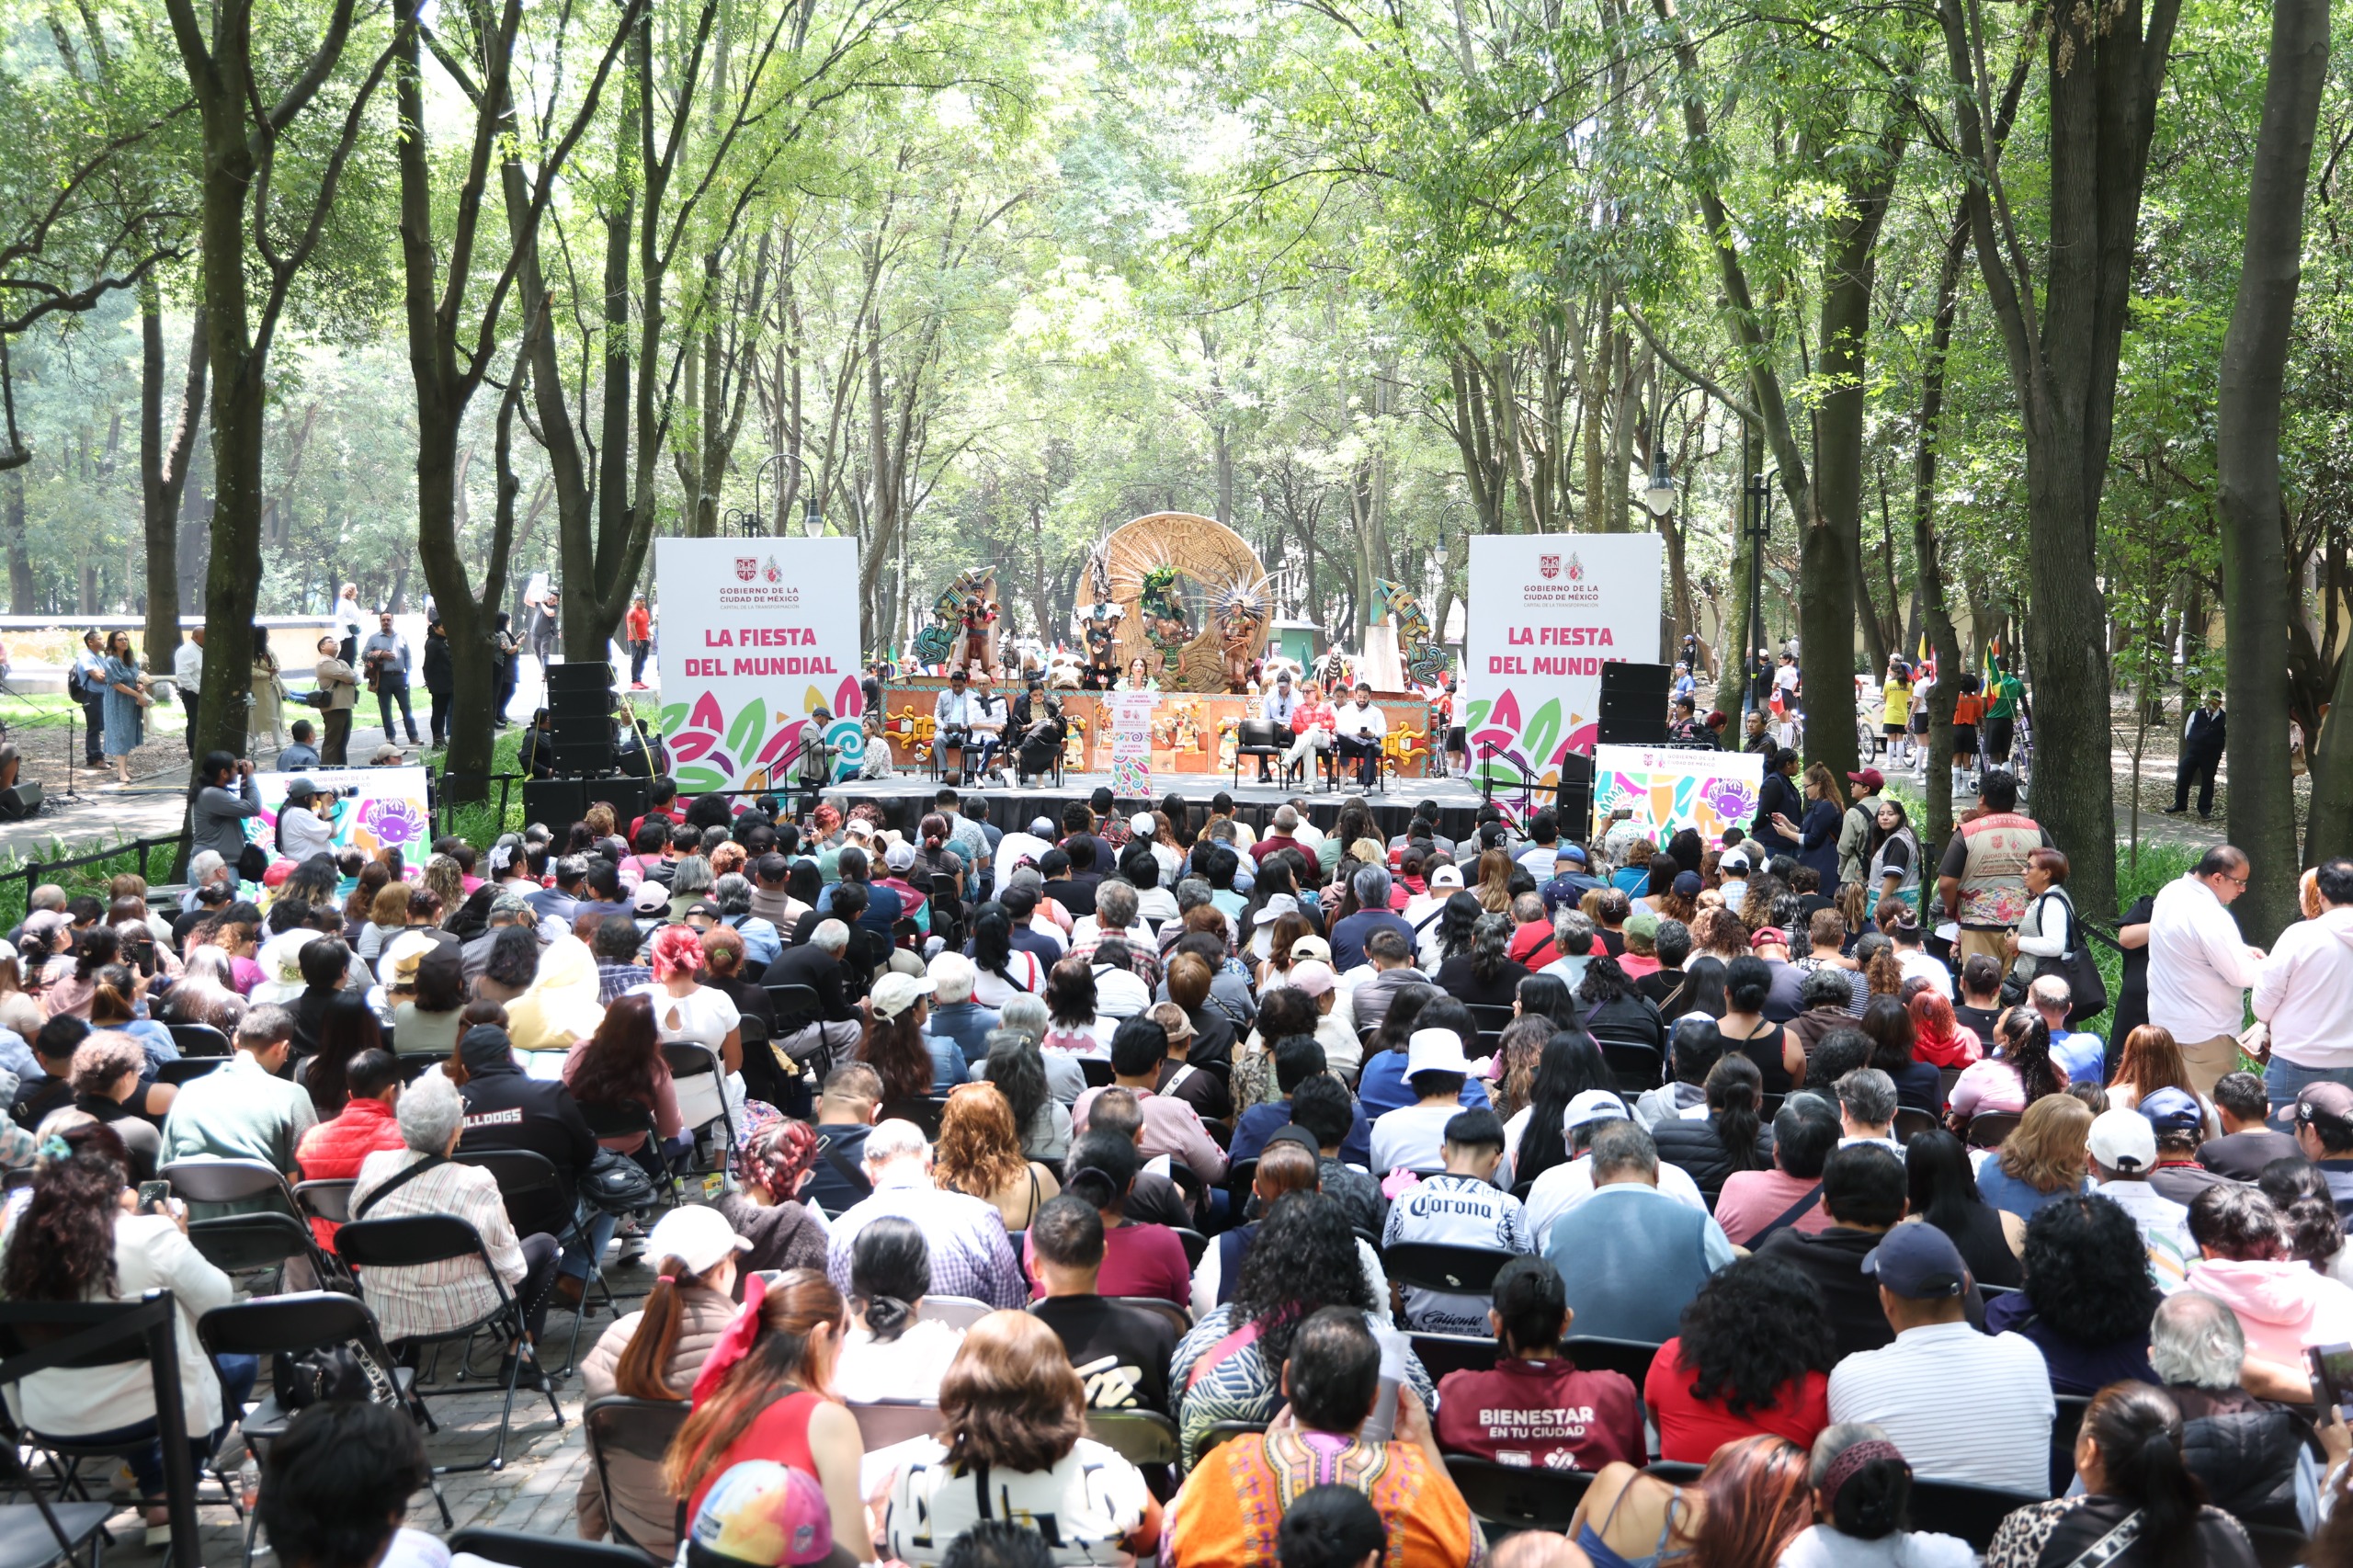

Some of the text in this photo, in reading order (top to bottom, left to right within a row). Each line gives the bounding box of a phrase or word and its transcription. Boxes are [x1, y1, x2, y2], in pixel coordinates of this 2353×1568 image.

[767, 595, 800, 603] MÉXICO
[1568, 592, 1599, 600] MÉXICO
[705, 628, 817, 647] LA FIESTA
[1508, 627, 1614, 646] LA FIESTA
[685, 656, 838, 676] DEL MUNDIAL
[1489, 655, 1627, 676] DEL MUNDI
[1409, 1193, 1492, 1220] Corona
[1479, 1405, 1595, 1426] BIENESTAR
[1488, 1425, 1586, 1438] EN TU CIUDAD
